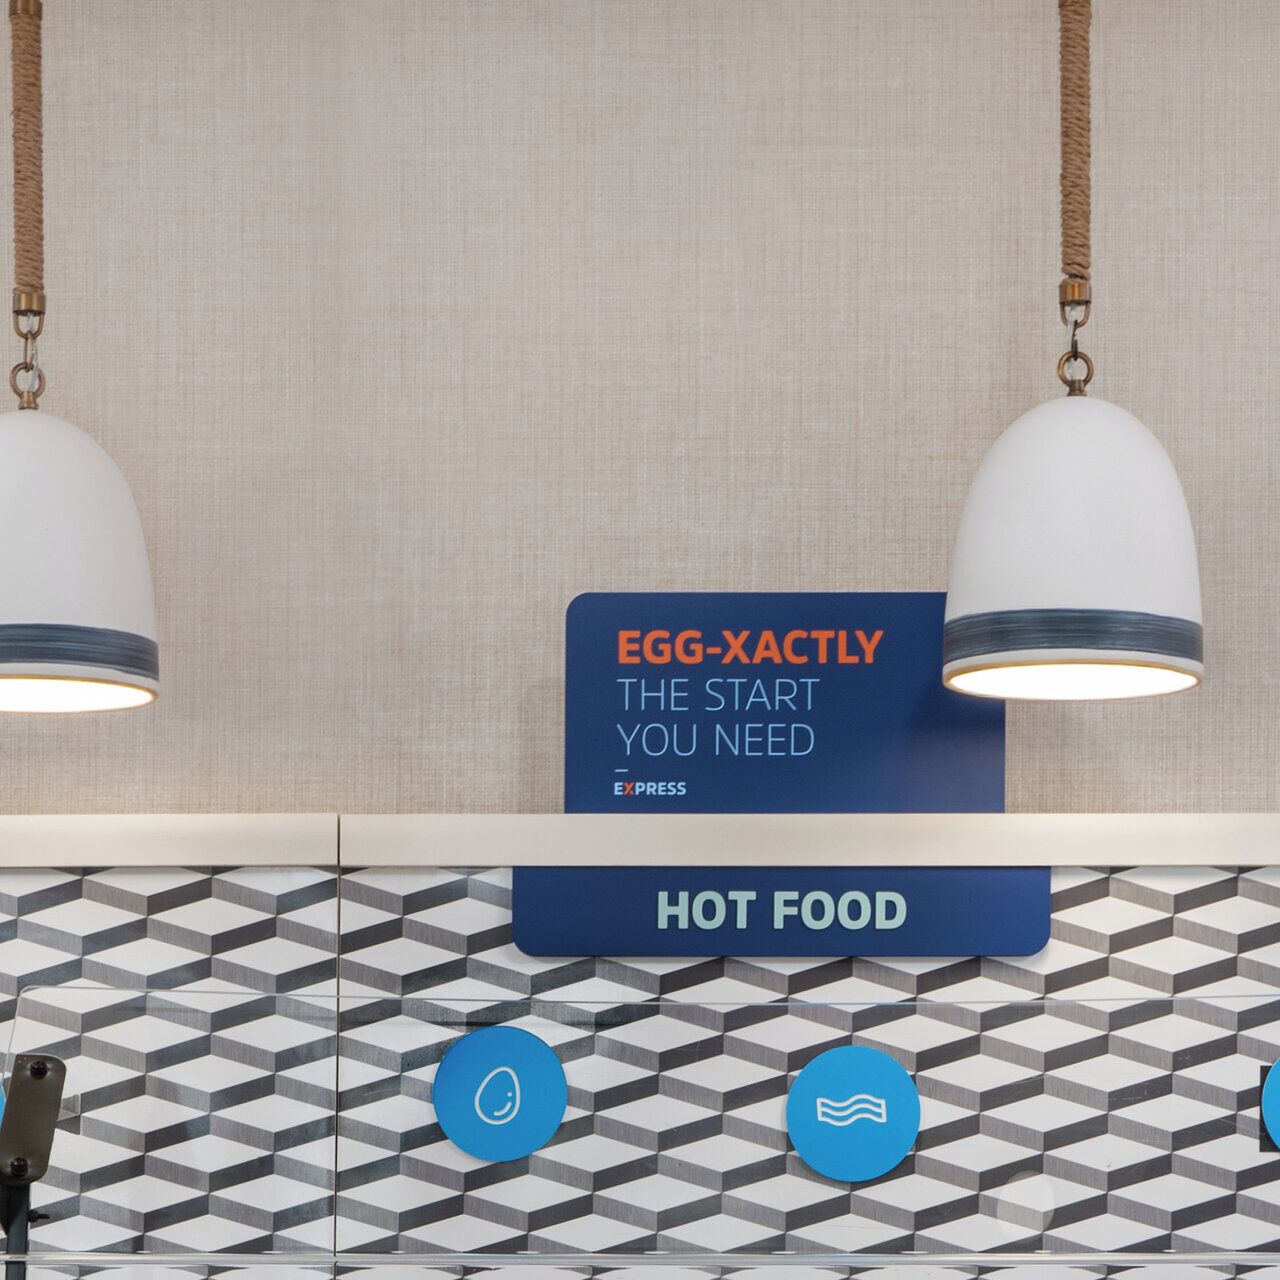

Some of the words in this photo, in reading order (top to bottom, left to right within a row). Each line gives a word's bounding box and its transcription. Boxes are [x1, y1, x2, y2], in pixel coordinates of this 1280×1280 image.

[618, 629, 884, 665] EGG-XACTLY
[616, 678, 689, 711] THE
[704, 678, 820, 712] START
[616, 723, 698, 757] YOU
[715, 723, 815, 757] NEED
[613, 781, 687, 796] EXPRESS
[656, 890, 757, 931] HOT
[773, 890, 908, 931] FOOD
